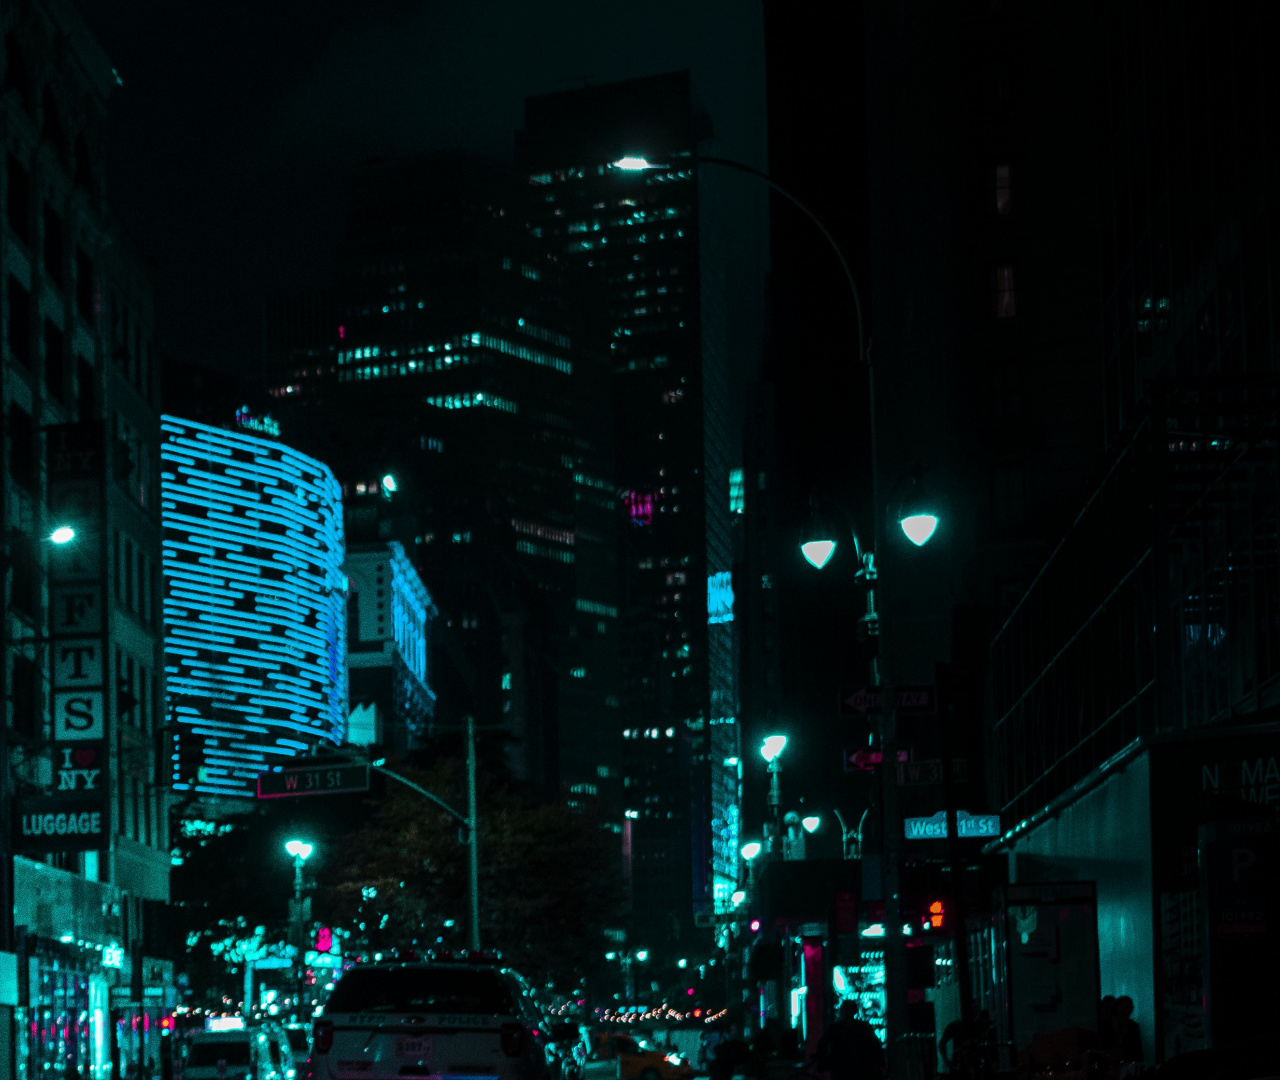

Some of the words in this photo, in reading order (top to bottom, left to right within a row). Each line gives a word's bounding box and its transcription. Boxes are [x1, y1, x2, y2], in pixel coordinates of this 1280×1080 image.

[62, 749, 72, 768] I
[58, 769, 100, 790] NY
[285, 774, 298, 790] W
[306, 772, 320, 789] 31
[326, 770, 341, 787] St
[22, 811, 101, 835] LUGGAGE
[910, 820, 947, 836] West
[978, 819, 994, 834] St
[1231, 847, 1256, 883] P
[437, 1014, 489, 1025] POLICE
